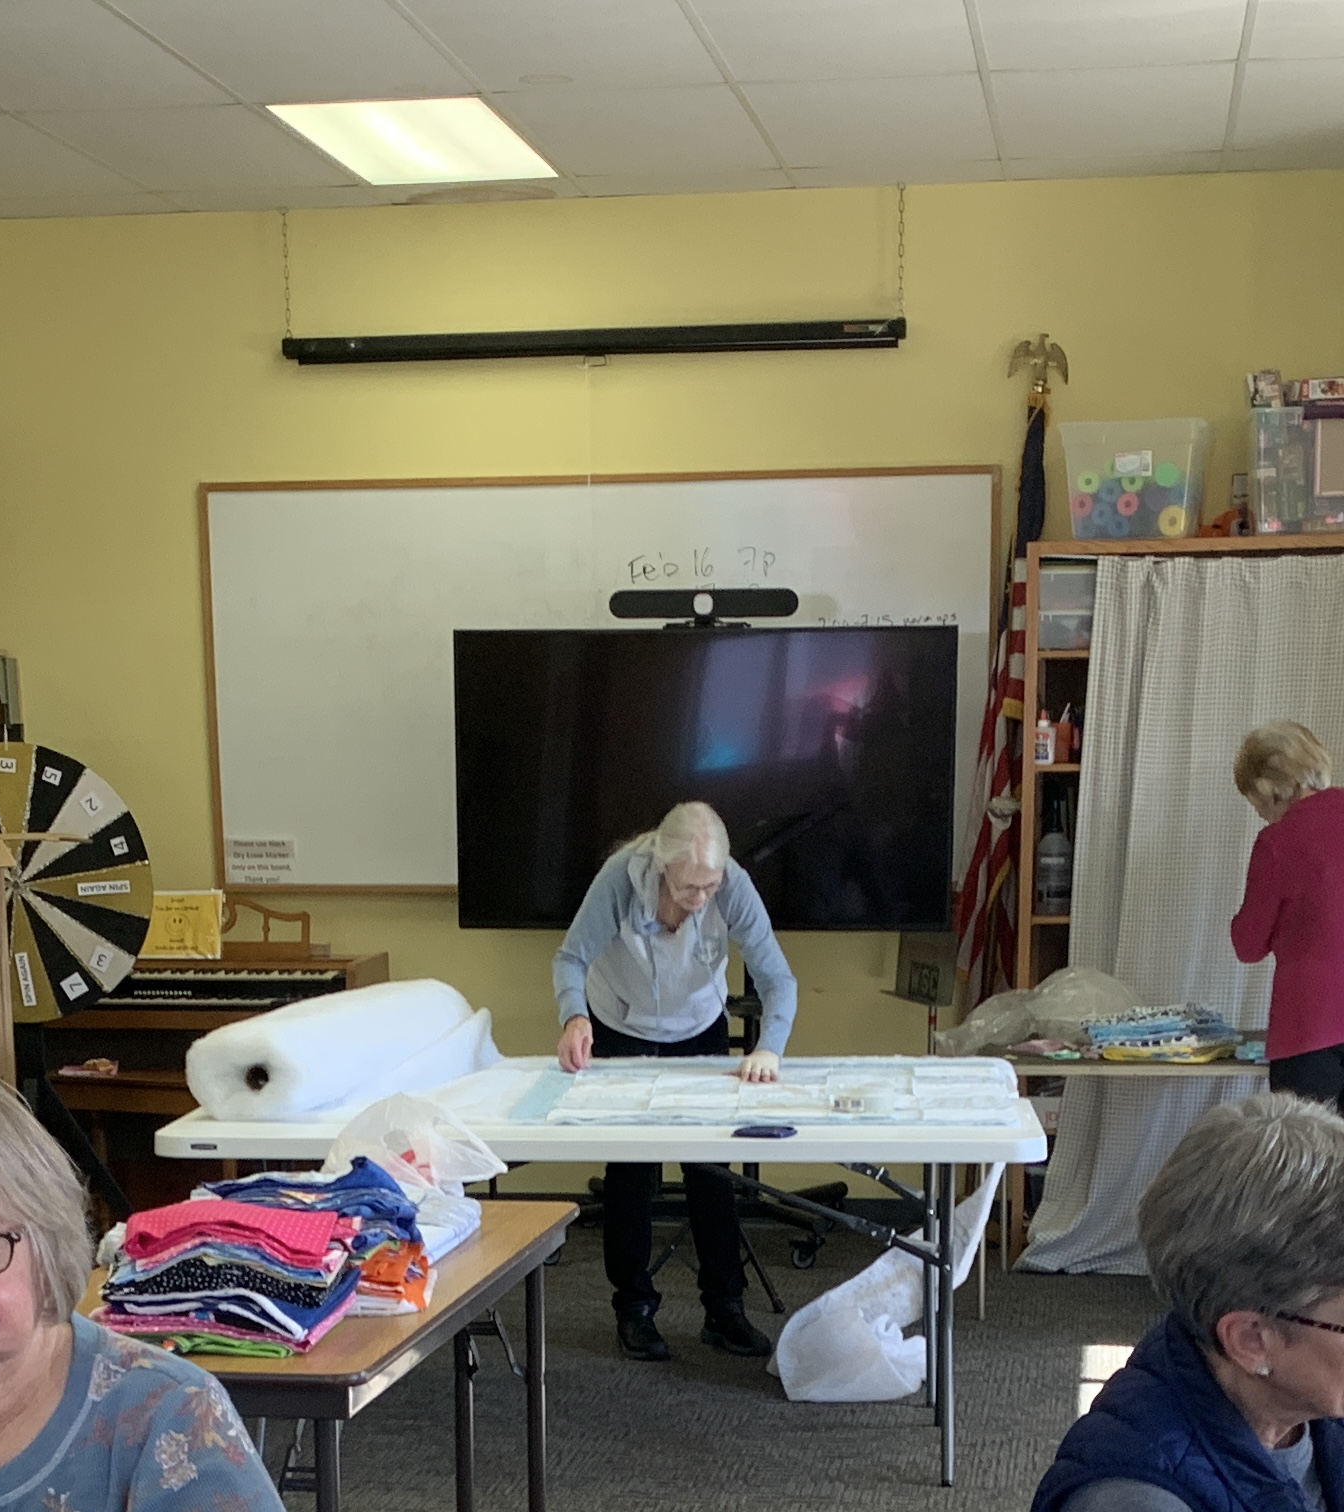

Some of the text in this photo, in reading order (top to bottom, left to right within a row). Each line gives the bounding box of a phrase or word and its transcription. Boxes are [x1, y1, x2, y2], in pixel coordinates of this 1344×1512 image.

[693, 547, 714, 577] 16
[0, 760, 14, 770] 3
[44, 769, 58, 780] 5
[85, 797, 99, 811] 2
[113, 841, 125, 851] 4
[80, 882, 129, 893] SPIN AGAIN
[96, 953, 108, 968] 3
[17, 955, 34, 1004] SPIN AGAIN
[69, 982, 82, 992] 7
